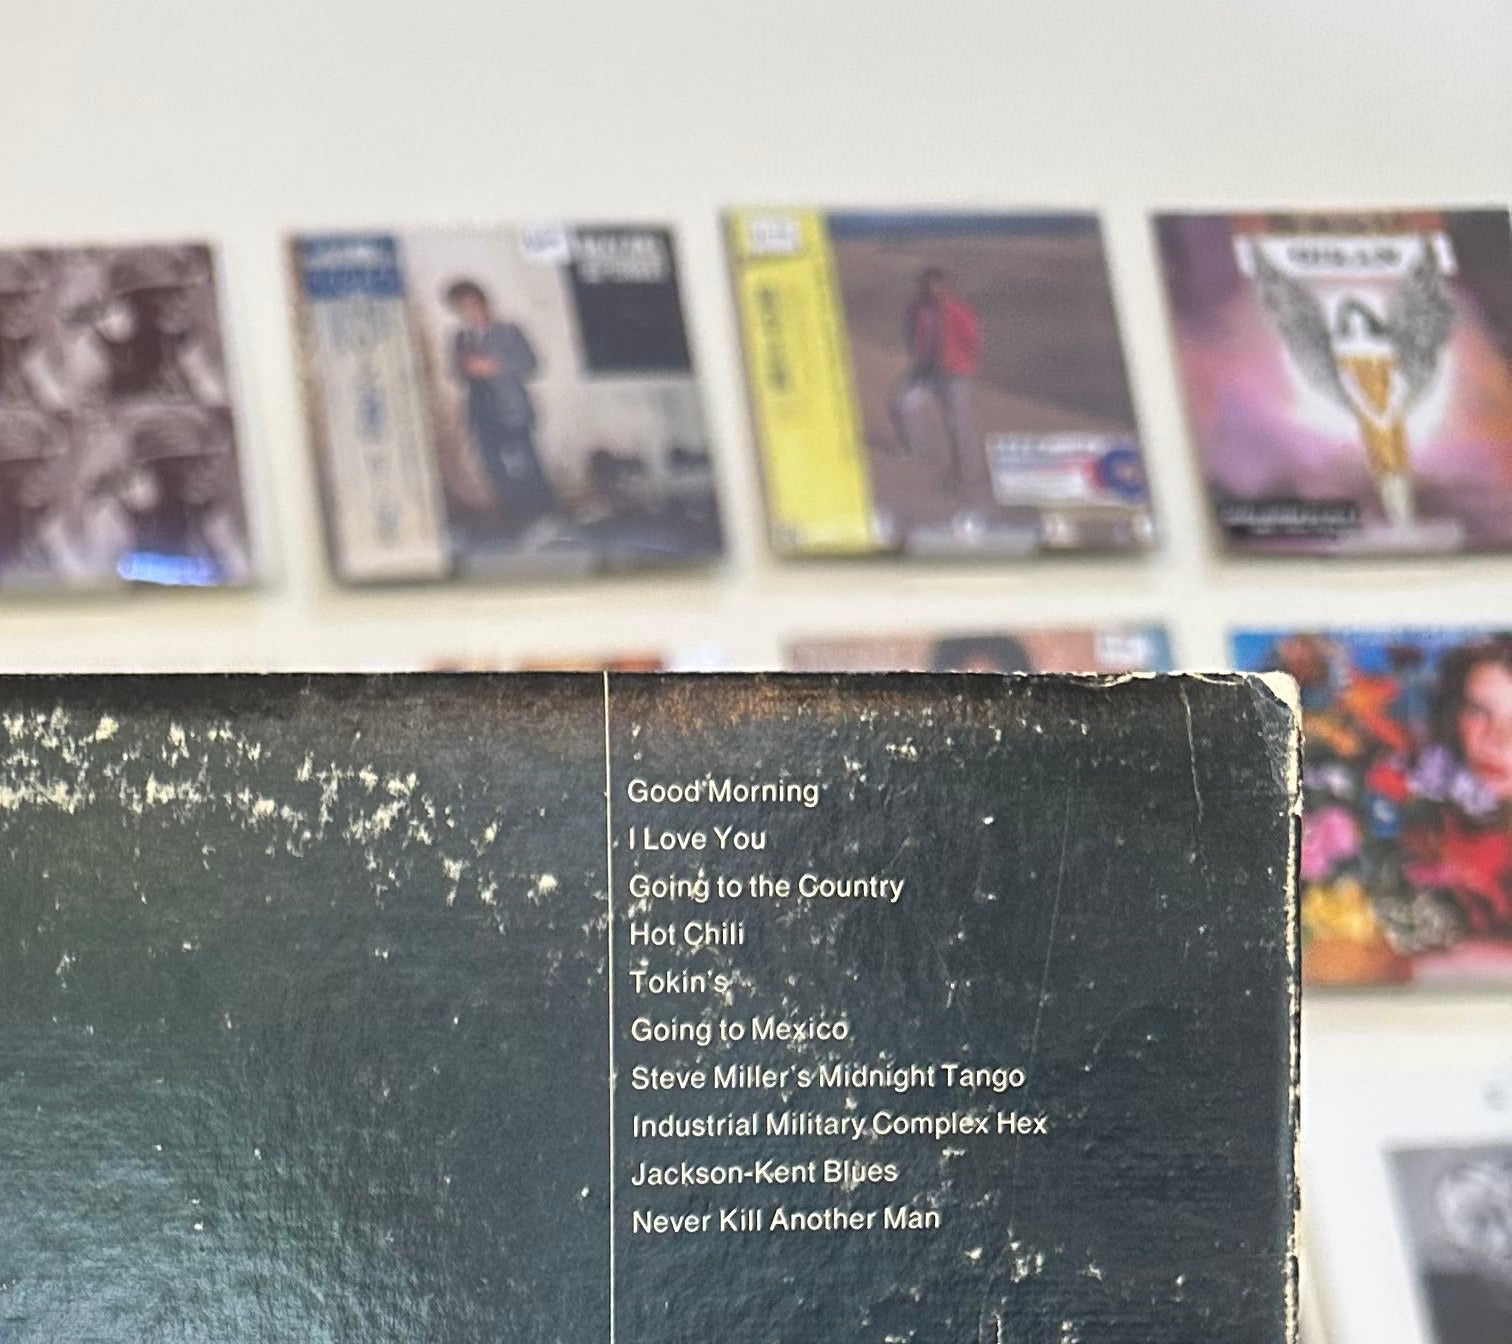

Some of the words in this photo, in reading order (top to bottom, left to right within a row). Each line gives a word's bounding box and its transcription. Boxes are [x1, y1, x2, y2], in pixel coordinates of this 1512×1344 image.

[628, 779, 700, 803] Good
[709, 780, 820, 807] Morning
[629, 828, 635, 850] I
[644, 827, 707, 850] Love
[714, 827, 767, 850] You
[630, 876, 710, 903] Going
[717, 877, 743, 898] to
[749, 875, 790, 897] the
[798, 874, 904, 903] Country
[630, 923, 676, 946] Hot
[684, 921, 745, 946] Chili
[630, 969, 729, 994] Tokin's
[631, 1018, 711, 1046] Going
[719, 1019, 745, 1041] to
[752, 1018, 849, 1042] Mexico
[631, 1067, 706, 1090] Steve
[714, 1065, 812, 1089] Miller's
[819, 1065, 935, 1092] Midnight
[942, 1065, 1025, 1093] Tango
[632, 1113, 757, 1138] Industrial
[767, 1112, 865, 1140] Military
[872, 1111, 989, 1141] Complex
[997, 1111, 1047, 1135] Hex
[632, 1161, 816, 1186] Jackson-Kent
[824, 1160, 899, 1183] Blues
[632, 1210, 711, 1234] Never
[720, 1208, 763, 1232] Kill
[770, 1207, 877, 1232] Another
[884, 1207, 940, 1231] Man
